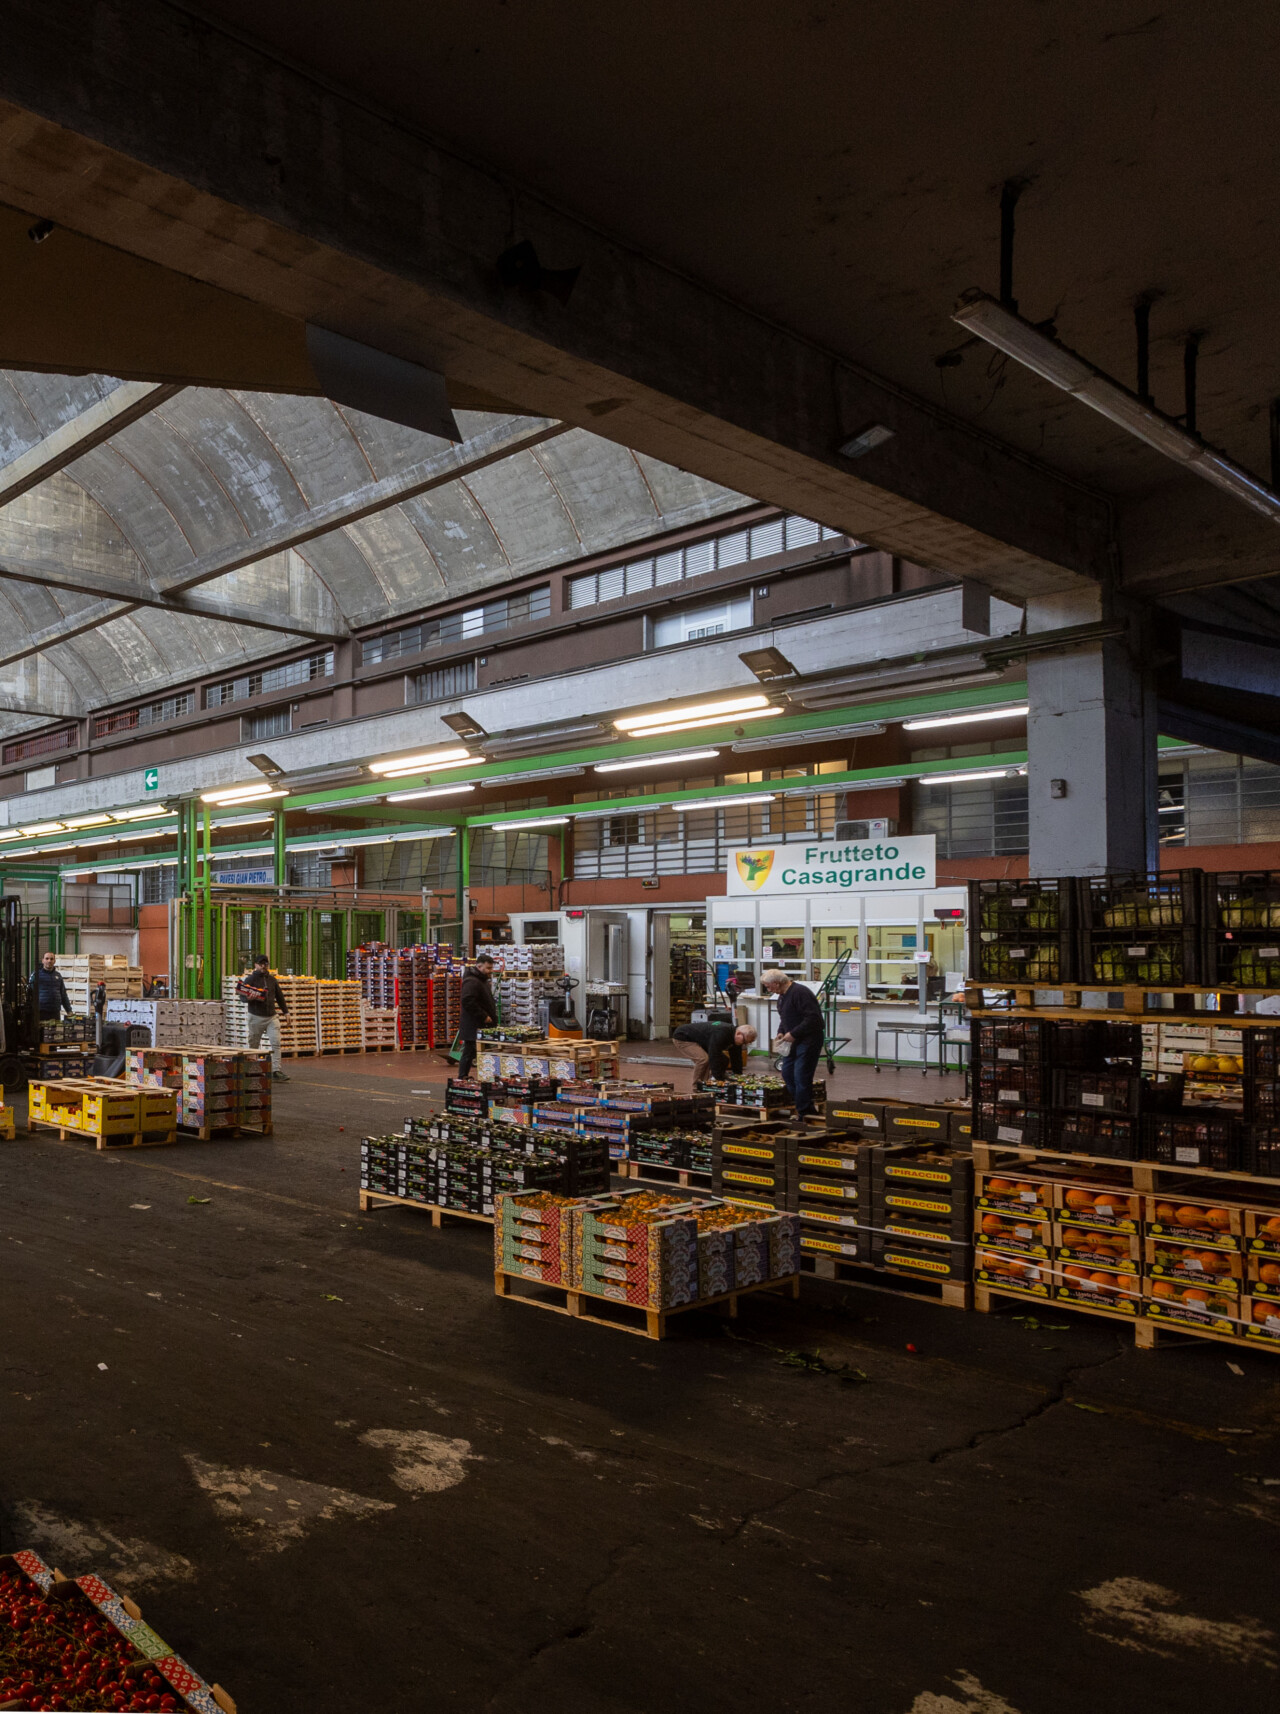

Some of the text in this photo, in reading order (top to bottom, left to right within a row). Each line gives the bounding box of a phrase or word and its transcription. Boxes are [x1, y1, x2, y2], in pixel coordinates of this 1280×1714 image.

[805, 844, 899, 864] Frutteto
[236, 873, 248, 884] GIAN
[249, 871, 266, 883] PIETRO
[782, 862, 926, 887] Casagrande
[1172, 1026, 1209, 1035] NAPPI
[838, 1111, 873, 1119] PIRACCINI
[899, 1119, 938, 1127] PIRACCINI
[729, 1146, 772, 1157] PIRACCINI
[806, 1157, 841, 1167] PIRACC
[730, 1173, 772, 1185] PIRACCINI
[893, 1167, 948, 1181] PIRACCINI
[807, 1184, 842, 1195] PIRACC
[894, 1197, 949, 1211] PIRACCINI
[806, 1212, 840, 1222] PIRACC
[806, 1240, 841, 1251] PIRACC
[893, 1256, 947, 1272] PIRACCINI
